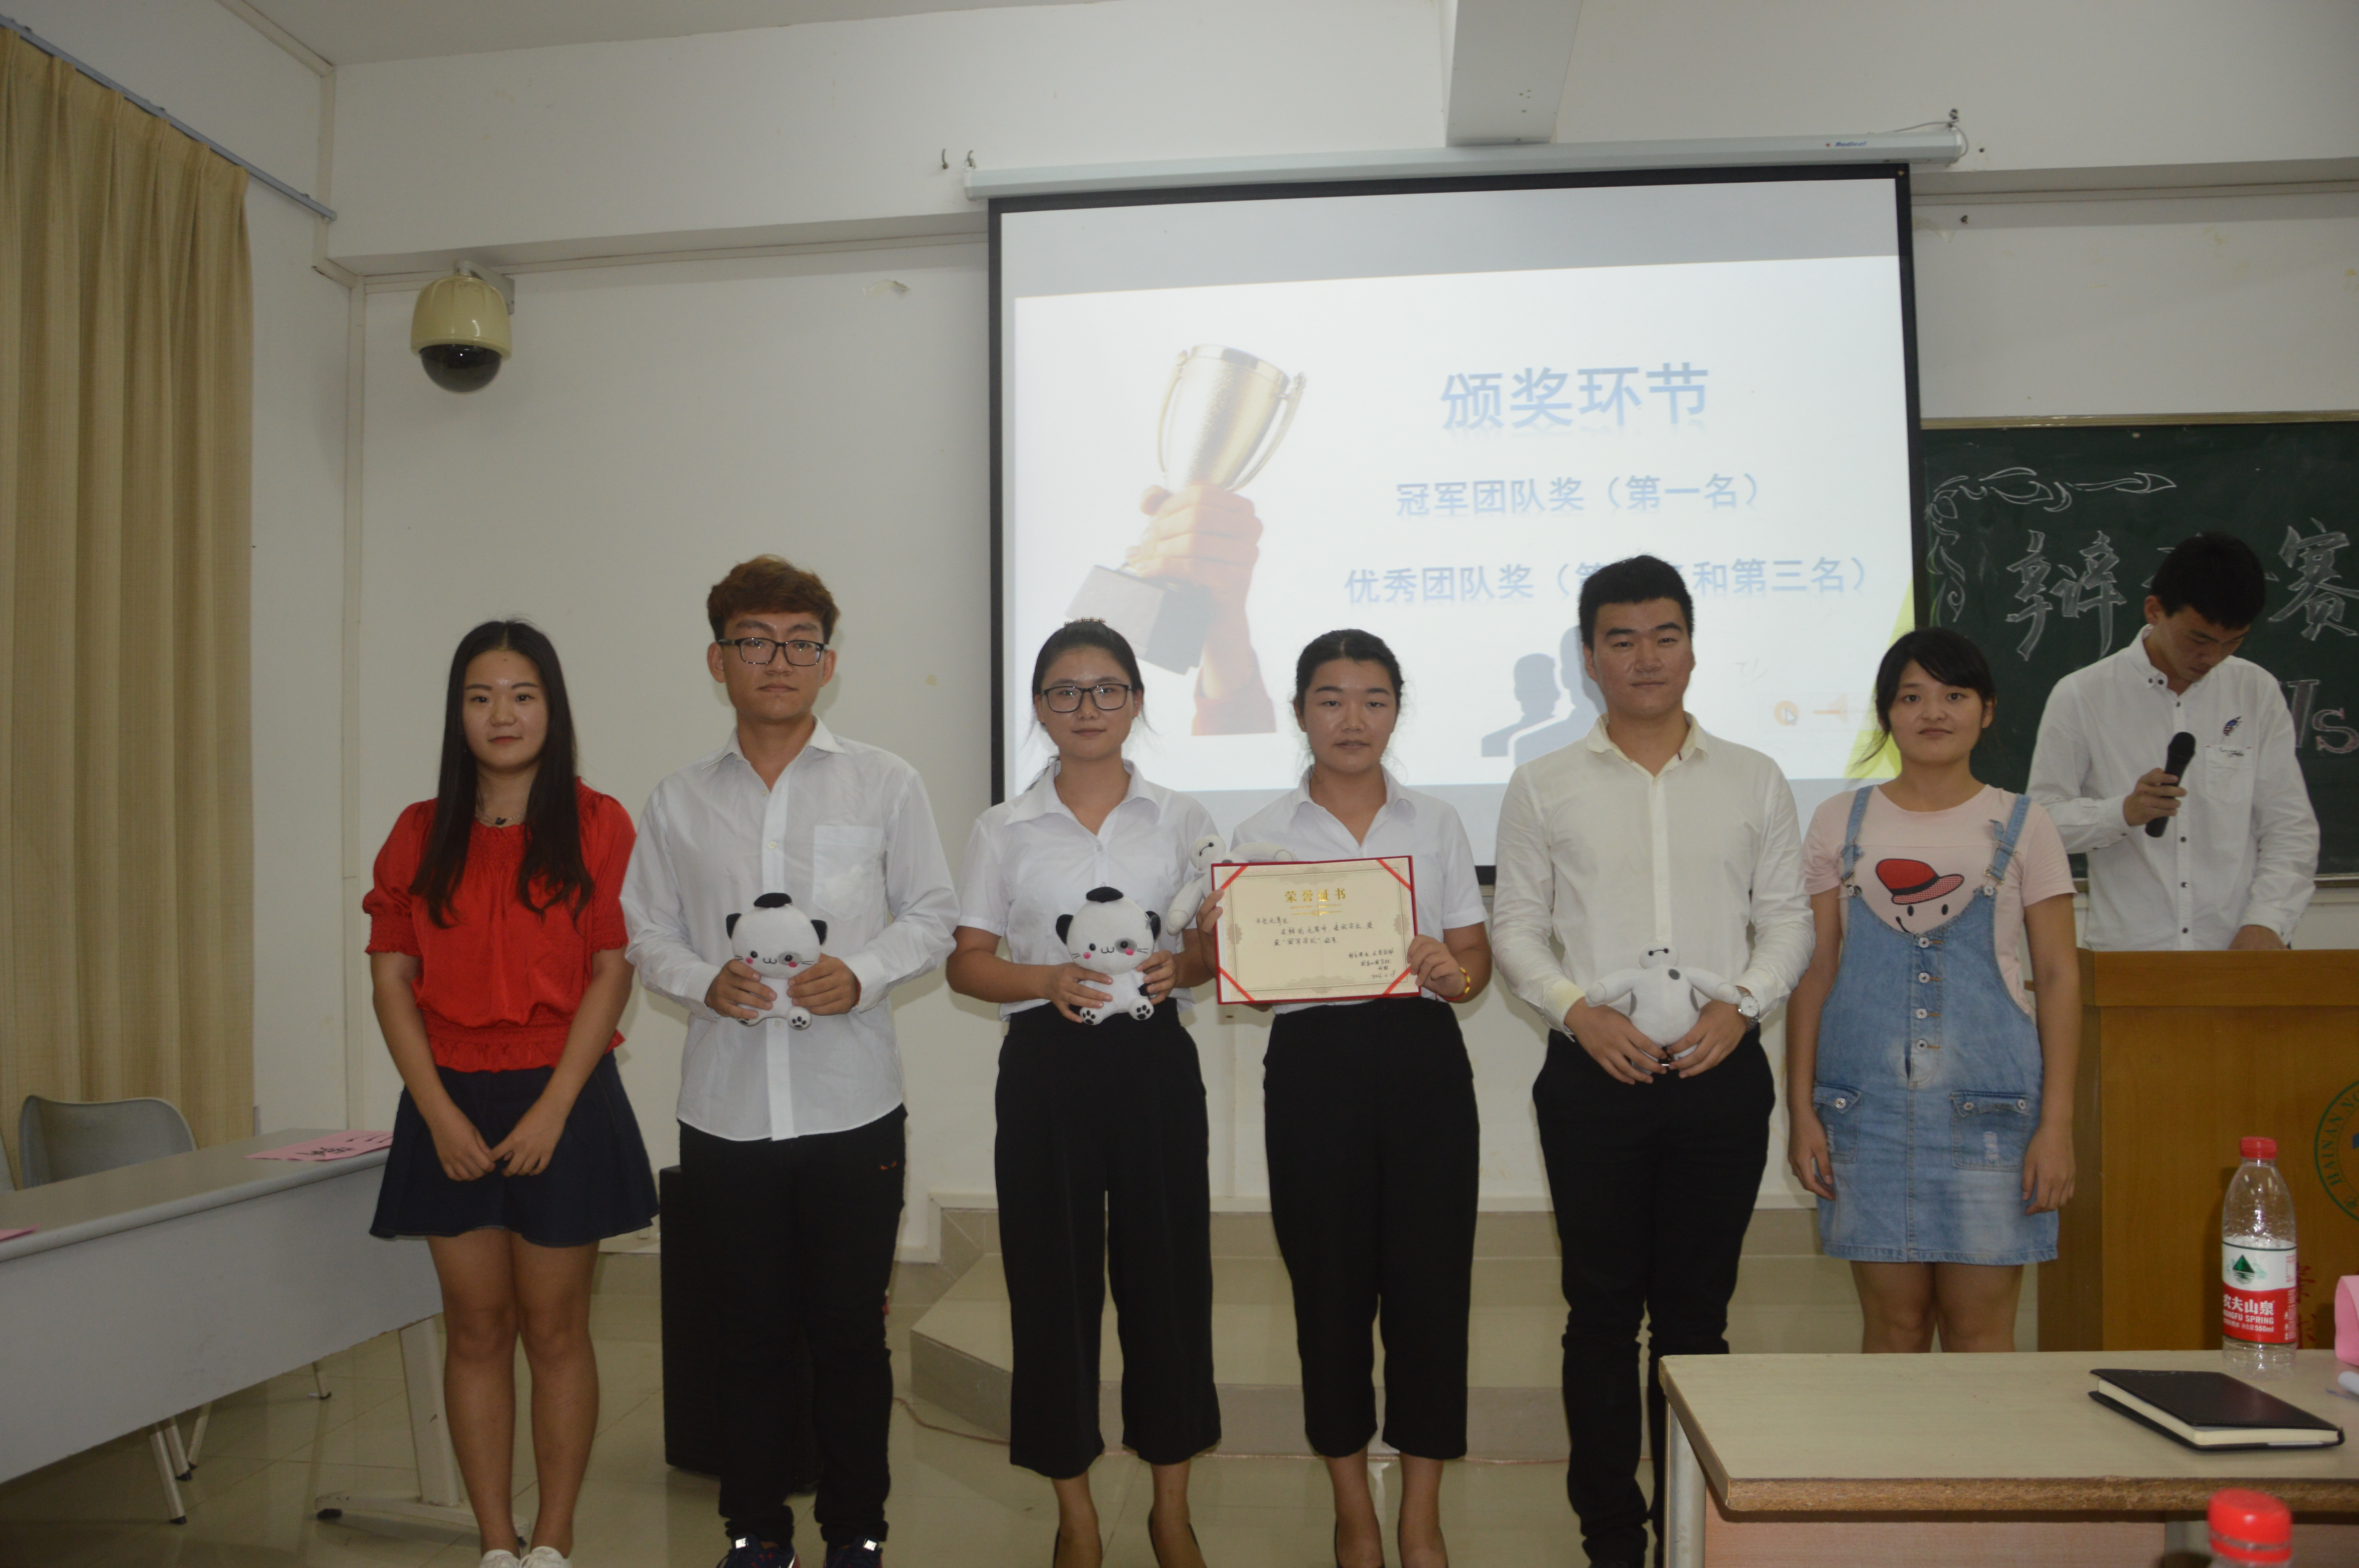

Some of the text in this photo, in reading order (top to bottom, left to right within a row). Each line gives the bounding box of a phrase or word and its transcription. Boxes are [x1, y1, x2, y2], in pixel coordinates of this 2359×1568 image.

[1440, 362, 1708, 430] 颁奖环节
[1396, 472, 1757, 516] 冠军团队奖（第一名）
[1285, 888, 1346, 902] 荣誉证书
[2224, 1294, 2274, 1315] 农夫山泉
[2246, 1315, 2274, 1324] SPRING
